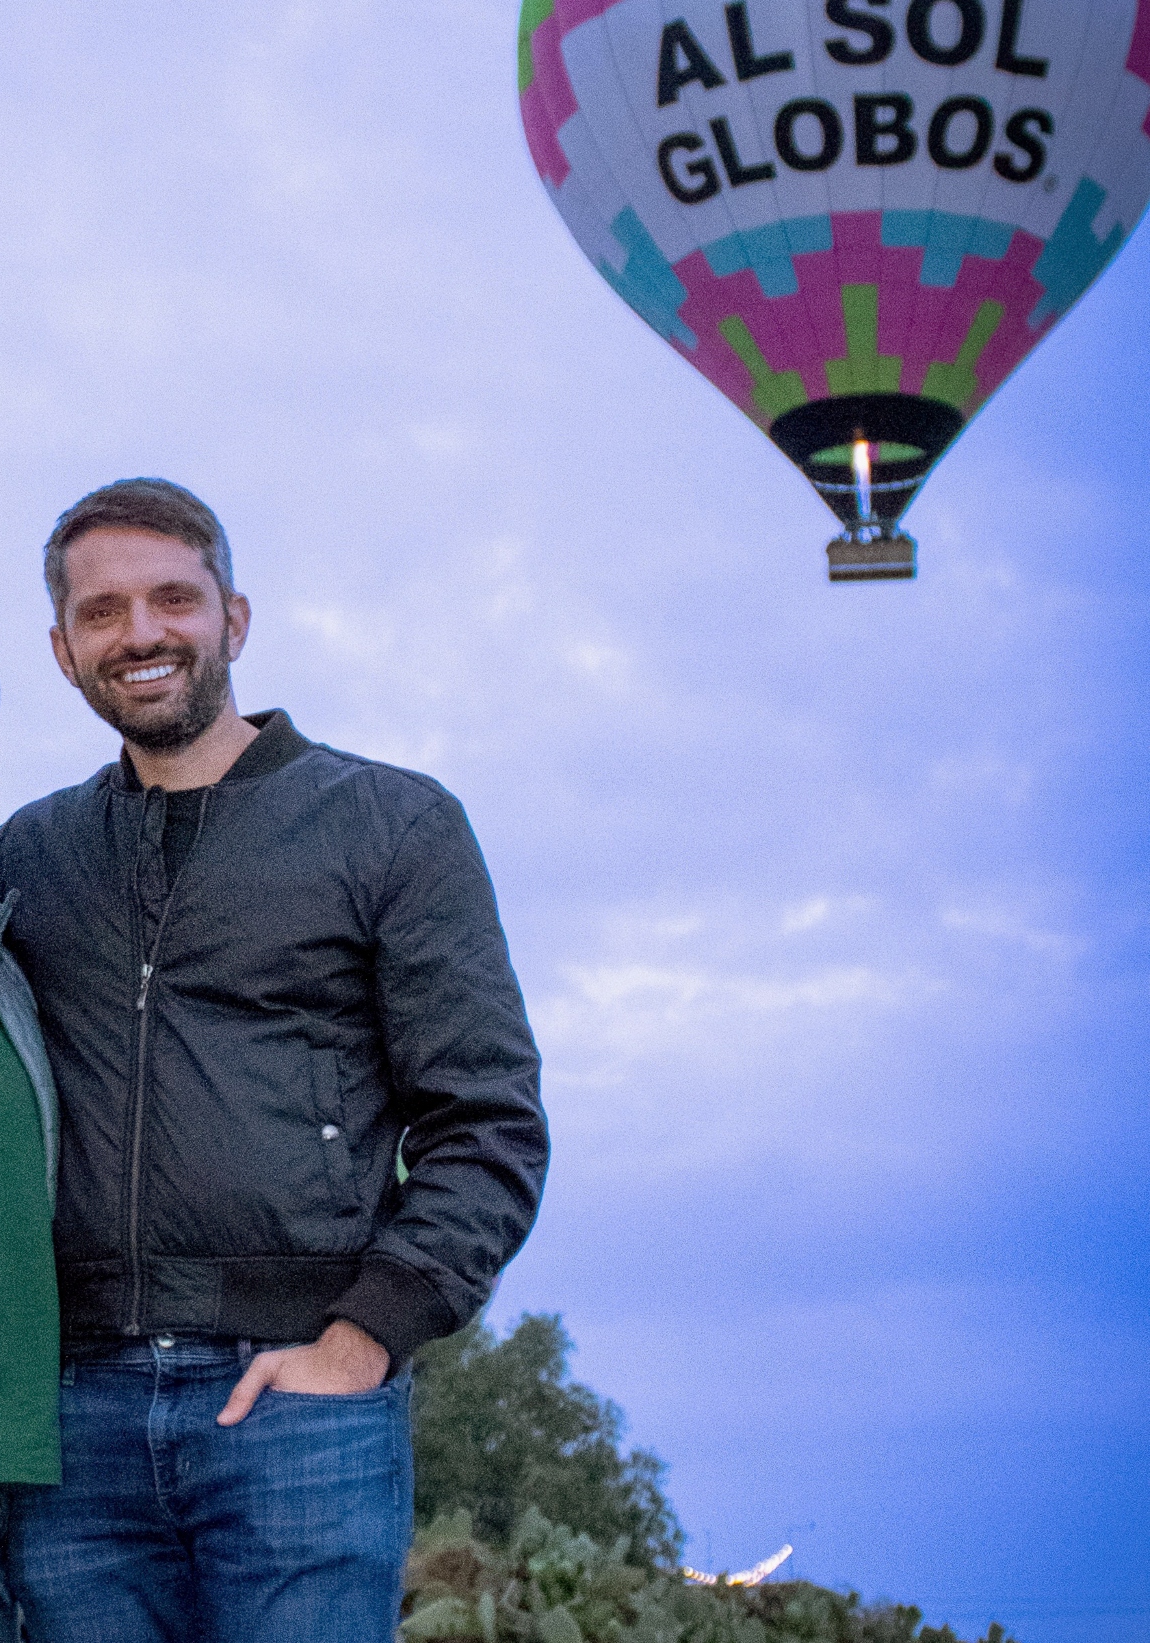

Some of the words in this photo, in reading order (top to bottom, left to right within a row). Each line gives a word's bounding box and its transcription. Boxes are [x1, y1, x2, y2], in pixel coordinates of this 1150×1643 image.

[657, 1, 796, 108] AL
[824, 0, 1048, 78] SOL
[656, 92, 1056, 205] GLOBOS
